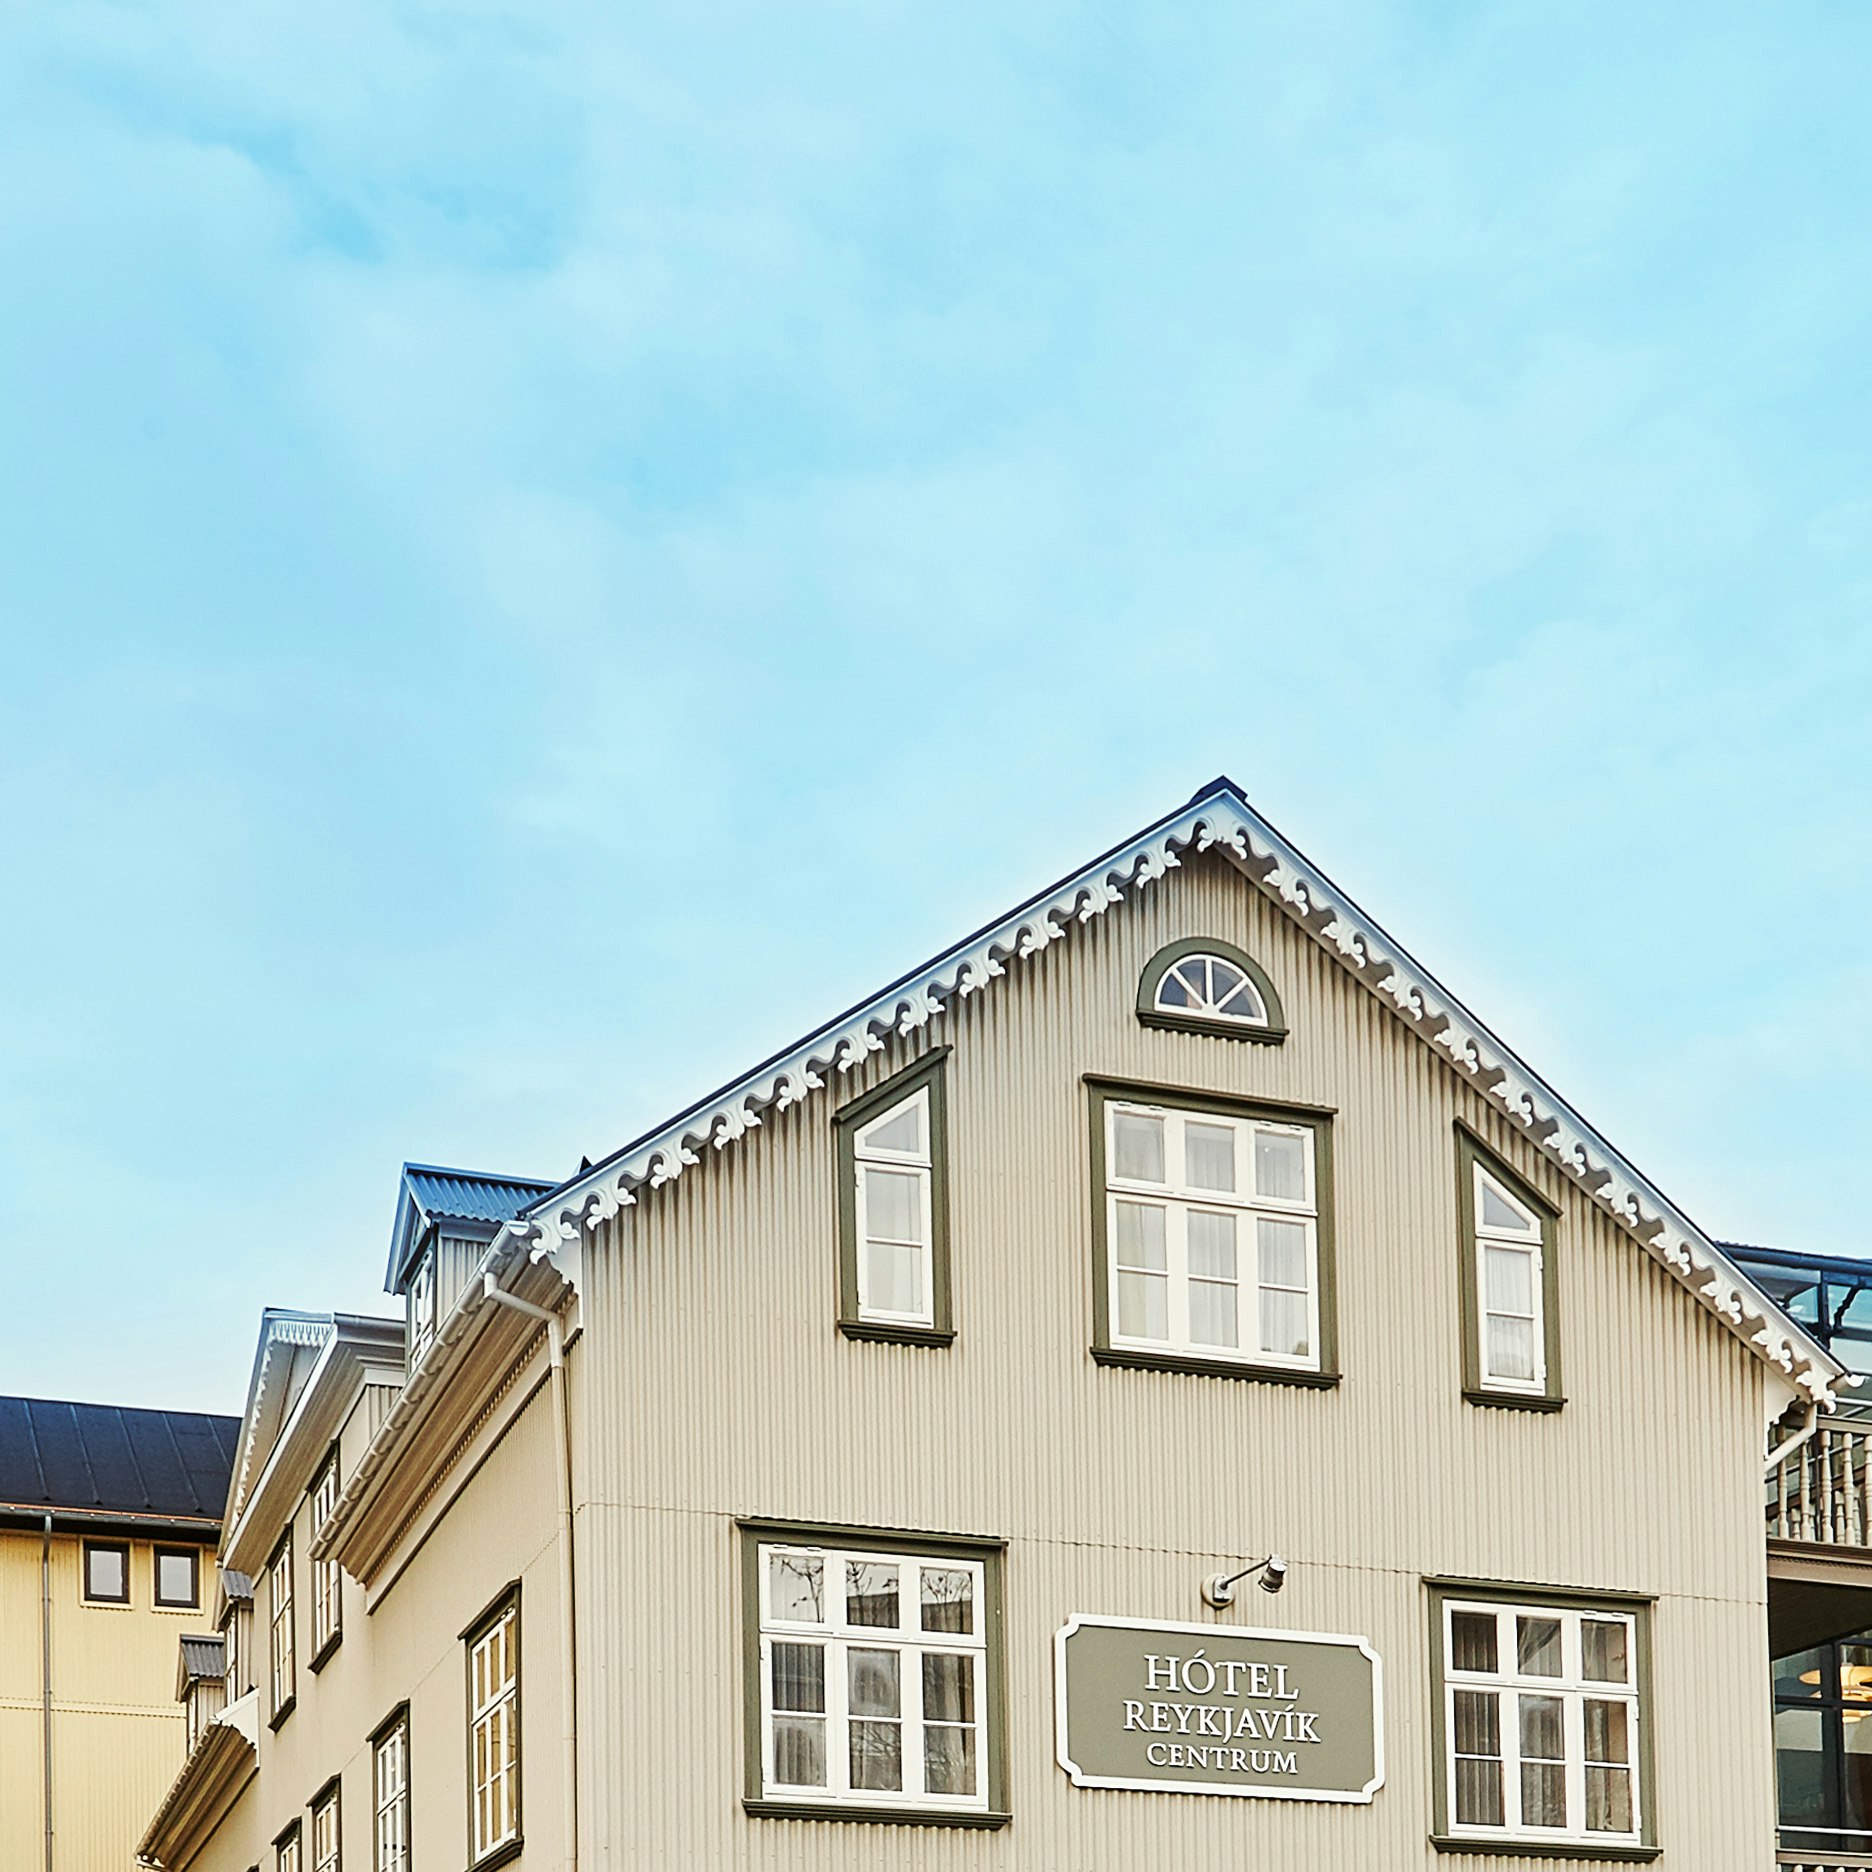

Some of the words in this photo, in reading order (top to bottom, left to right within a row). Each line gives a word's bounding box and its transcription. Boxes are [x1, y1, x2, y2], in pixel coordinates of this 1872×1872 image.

[1144, 1649, 1300, 1700] HÓTEL
[1123, 1700, 1321, 1743] REYKJAVÍK
[1146, 1743, 1298, 1774] CENTRUM
